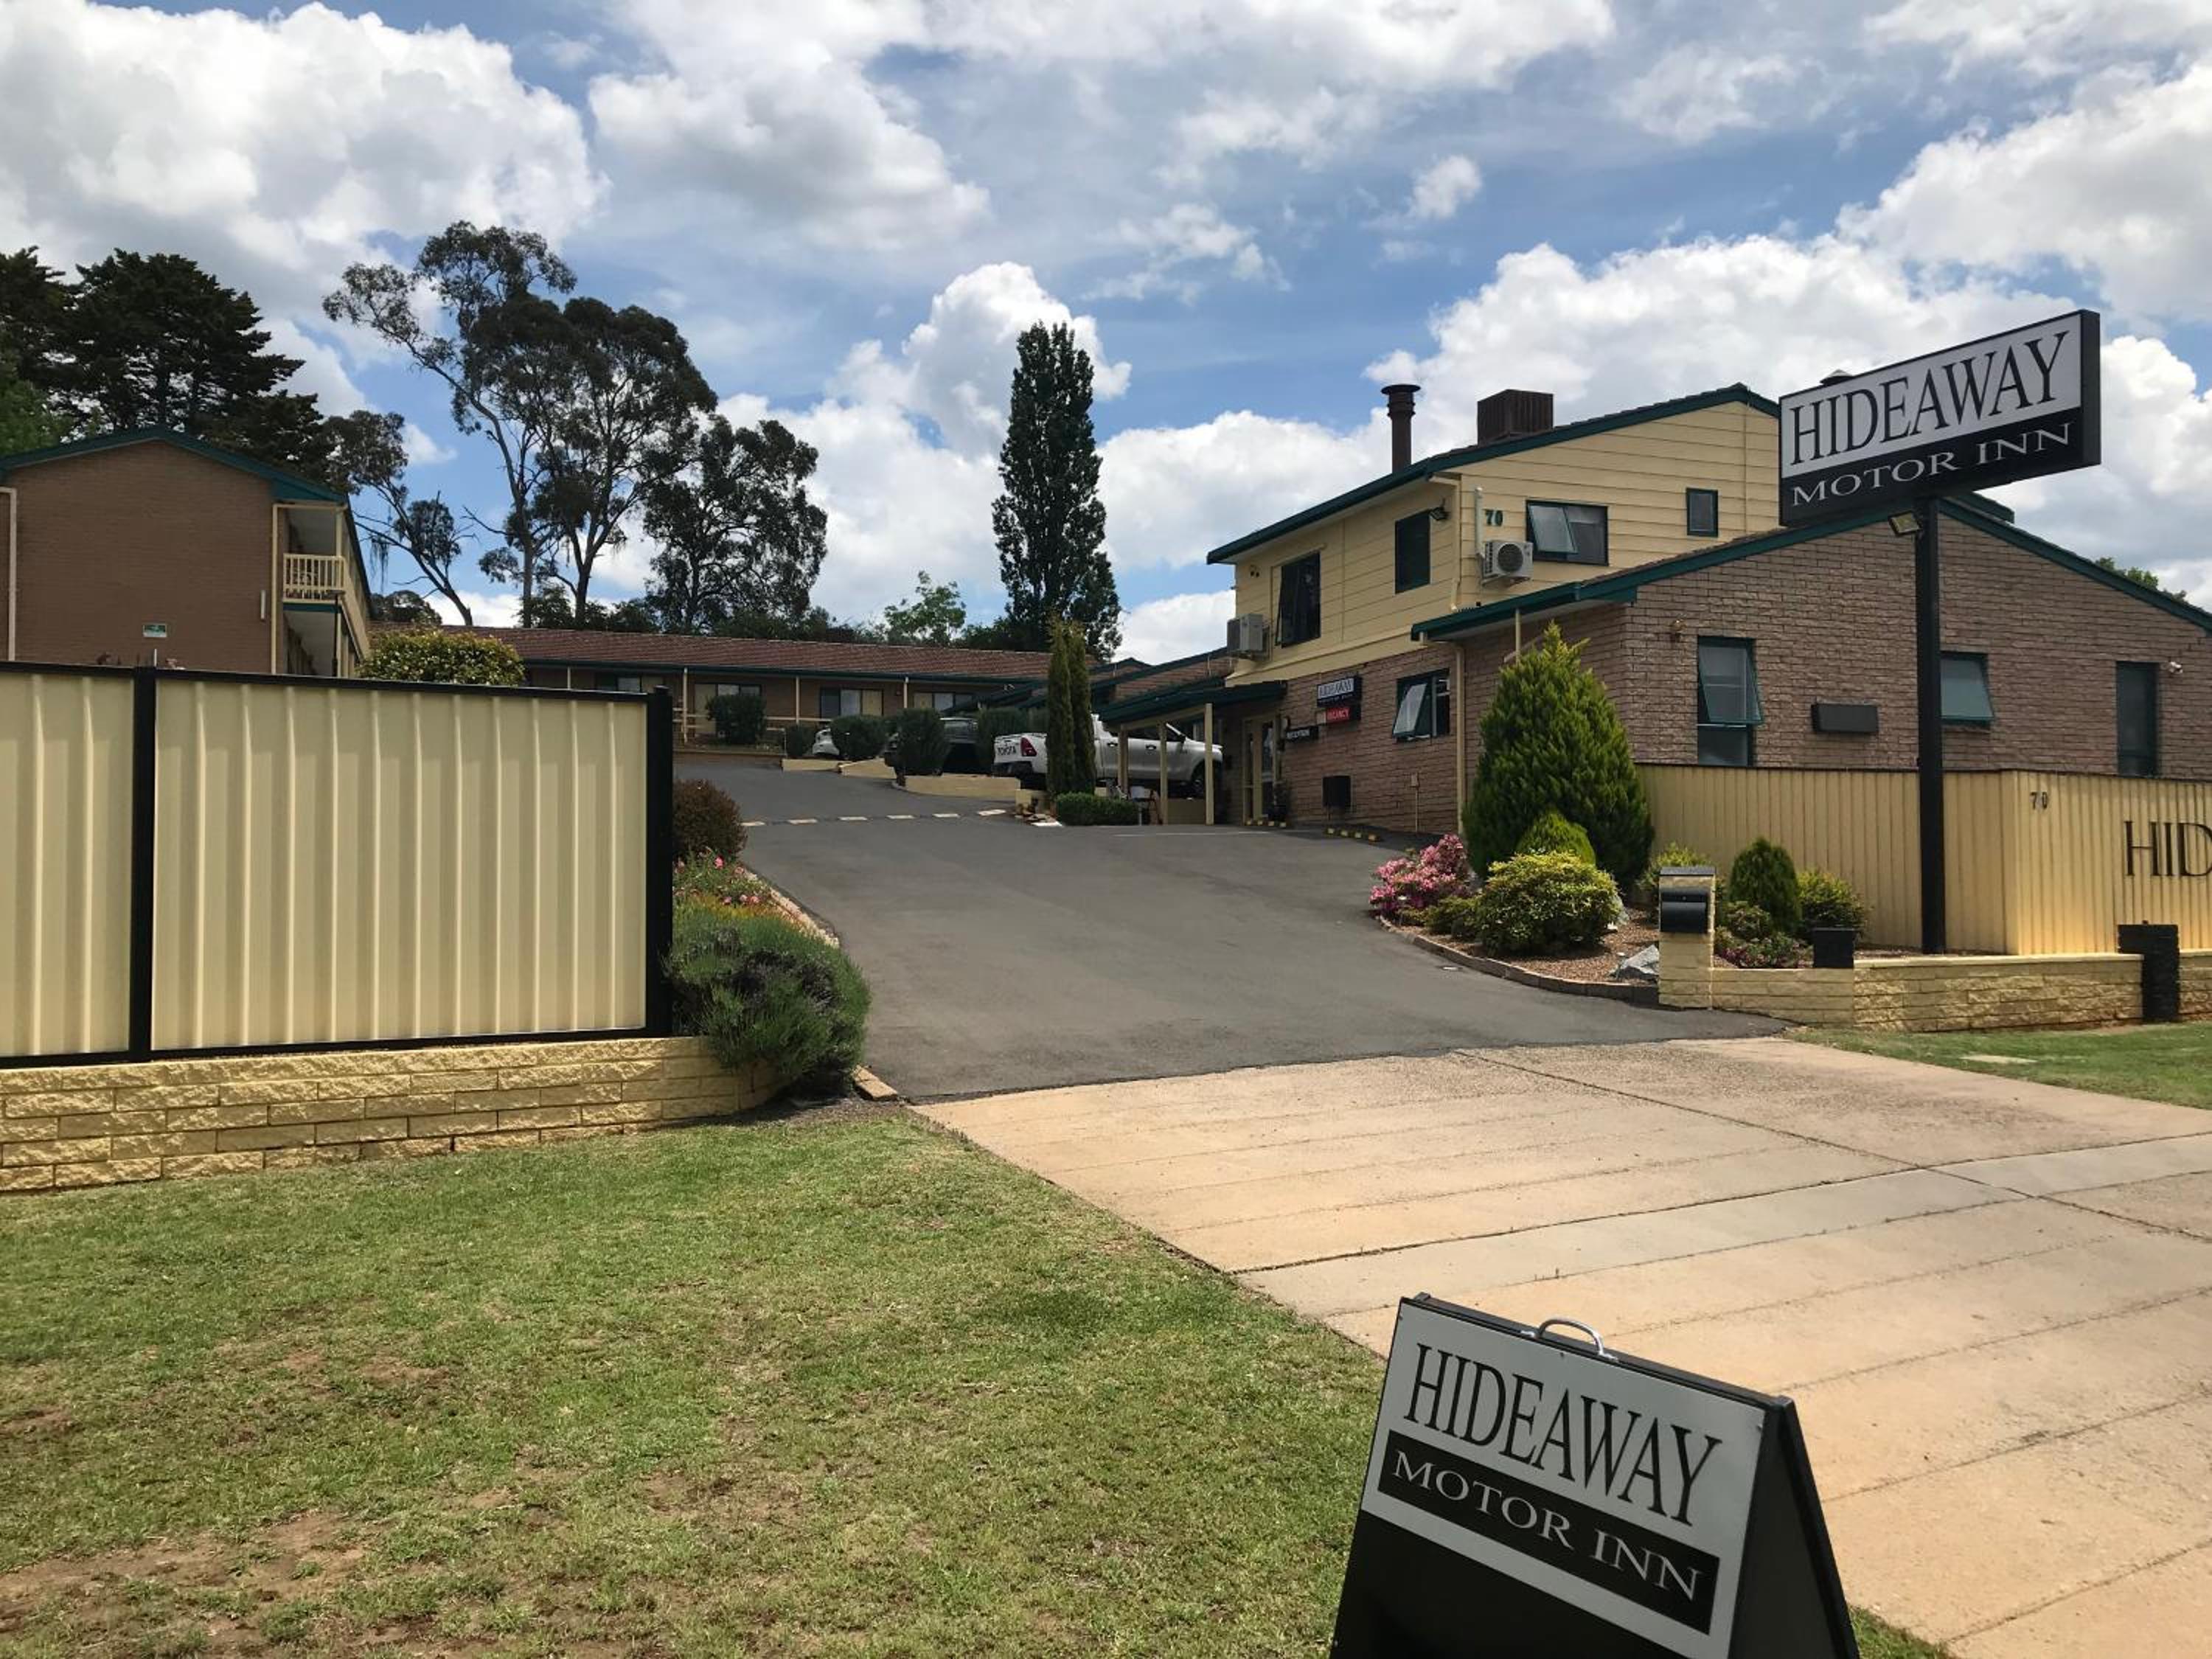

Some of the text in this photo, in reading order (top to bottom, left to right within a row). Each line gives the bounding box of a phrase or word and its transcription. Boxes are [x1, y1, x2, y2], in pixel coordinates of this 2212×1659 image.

[1789, 330, 2071, 466] HIDEAWAY
[1792, 422, 2076, 507] MOTOR INN
[1484, 509, 1503, 526] 70
[2030, 791, 2049, 810] 70
[2124, 821, 2212, 877] HID
[1403, 1343, 1722, 1528] HIDEAWAY
[1394, 1450, 1701, 1601] MOTOR INN
